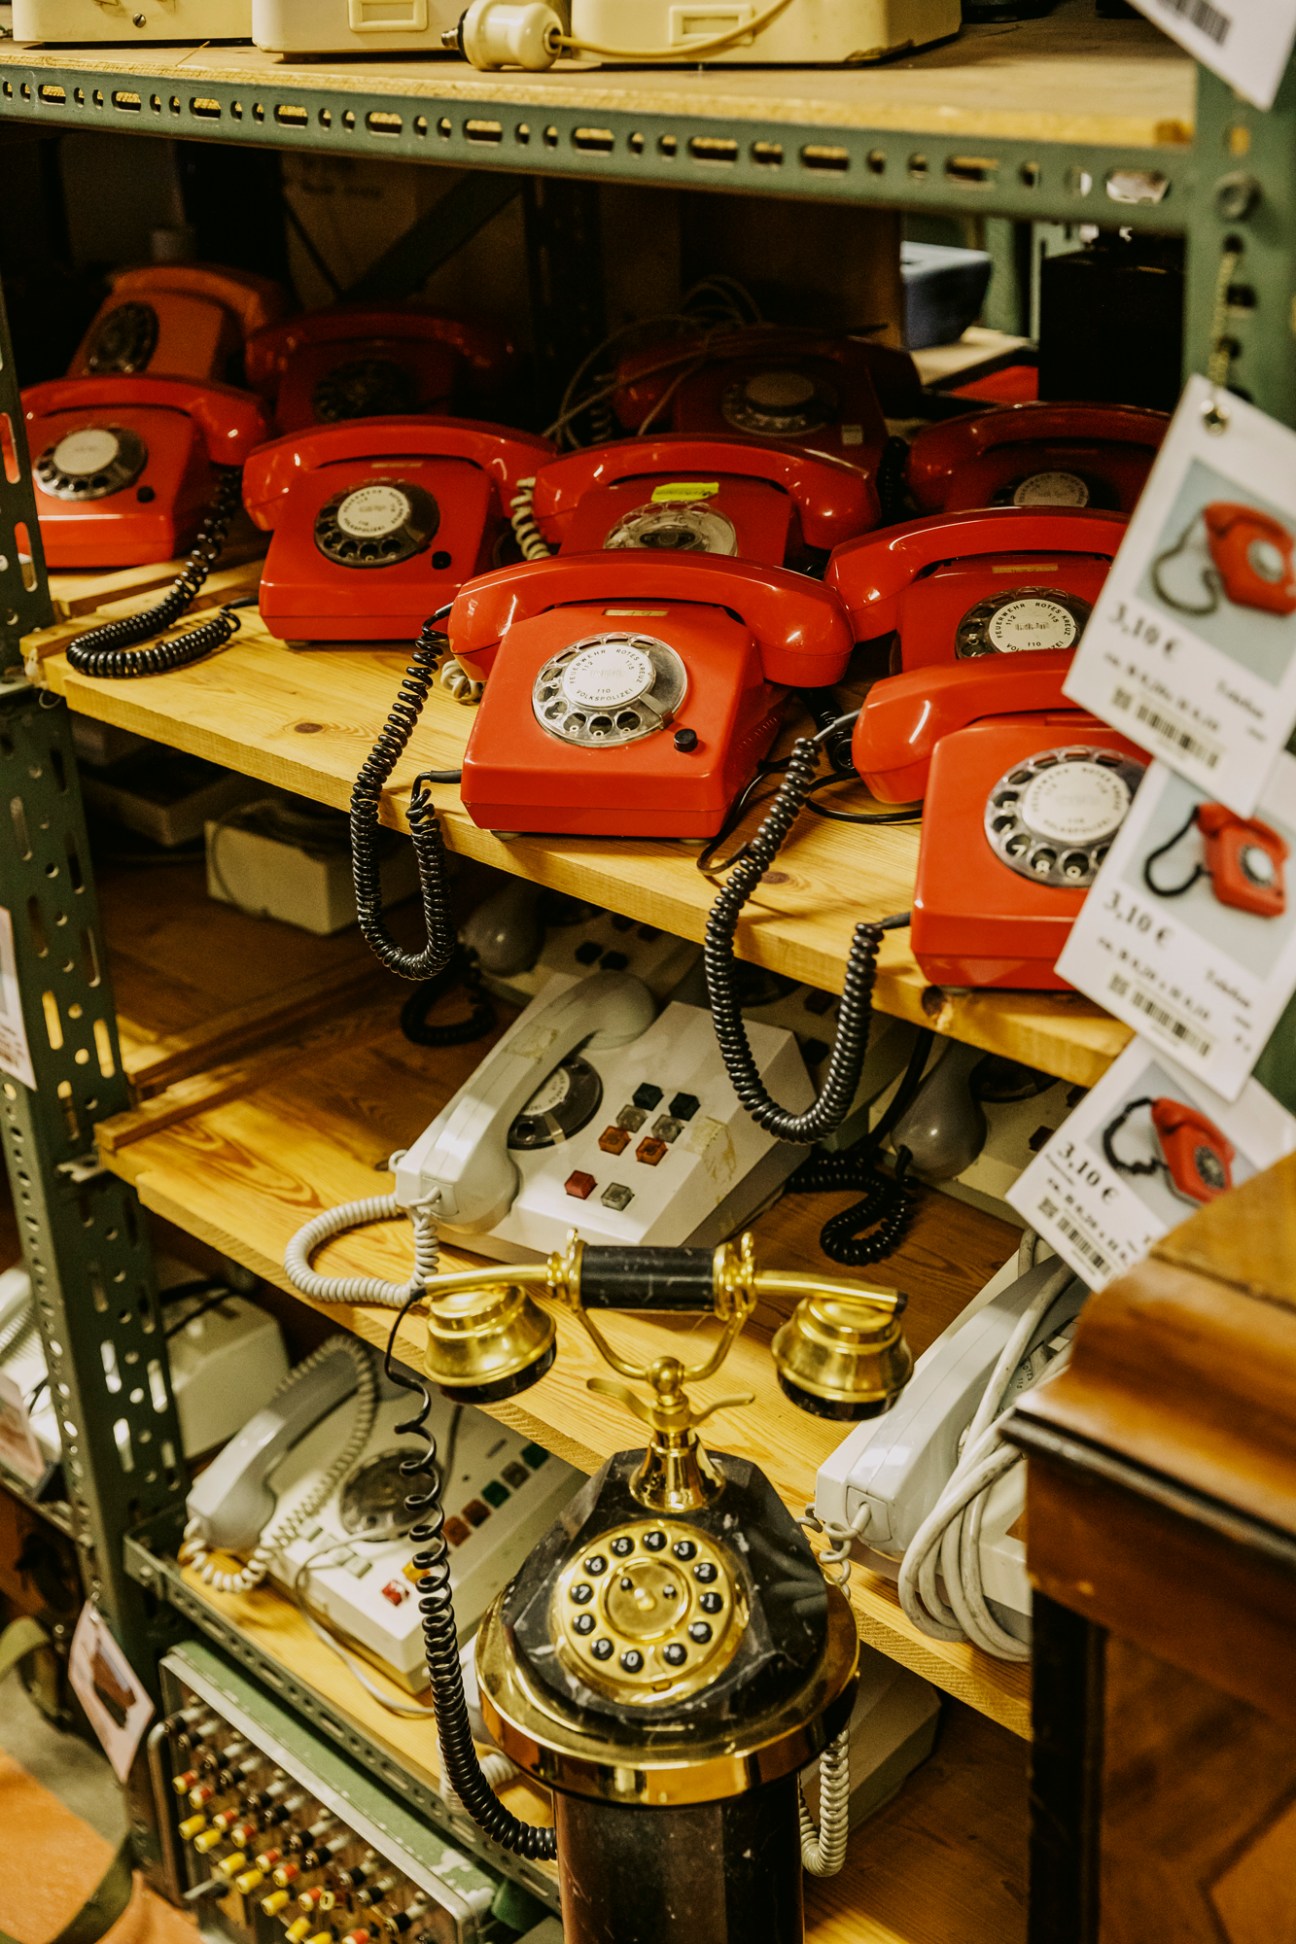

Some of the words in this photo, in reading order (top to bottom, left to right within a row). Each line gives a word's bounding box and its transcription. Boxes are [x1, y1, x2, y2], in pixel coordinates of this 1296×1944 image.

[995, 603, 1026, 639] FEUERWEHR
[1035, 602, 1062, 614] ROTES
[1062, 615, 1072, 636] KREUZ
[616, 648, 640, 661] ROTES
[576, 688, 634, 702] VOLKSPOLIZEI
[1104, 890, 1152, 934] 3,10
[1058, 1142, 1102, 1187] 3,10
[1101, 1186, 1118, 1206] €
[617, 1540, 628, 1551] 5
[649, 1534, 659, 1545] 4
[680, 1543, 689, 1555] 3
[591, 1559, 602, 1571] 6
[700, 1564, 711, 1577] 2
[578, 1586, 589, 1599] 7
[707, 1596, 714, 1608] 1
[627, 1652, 638, 1666] 0
